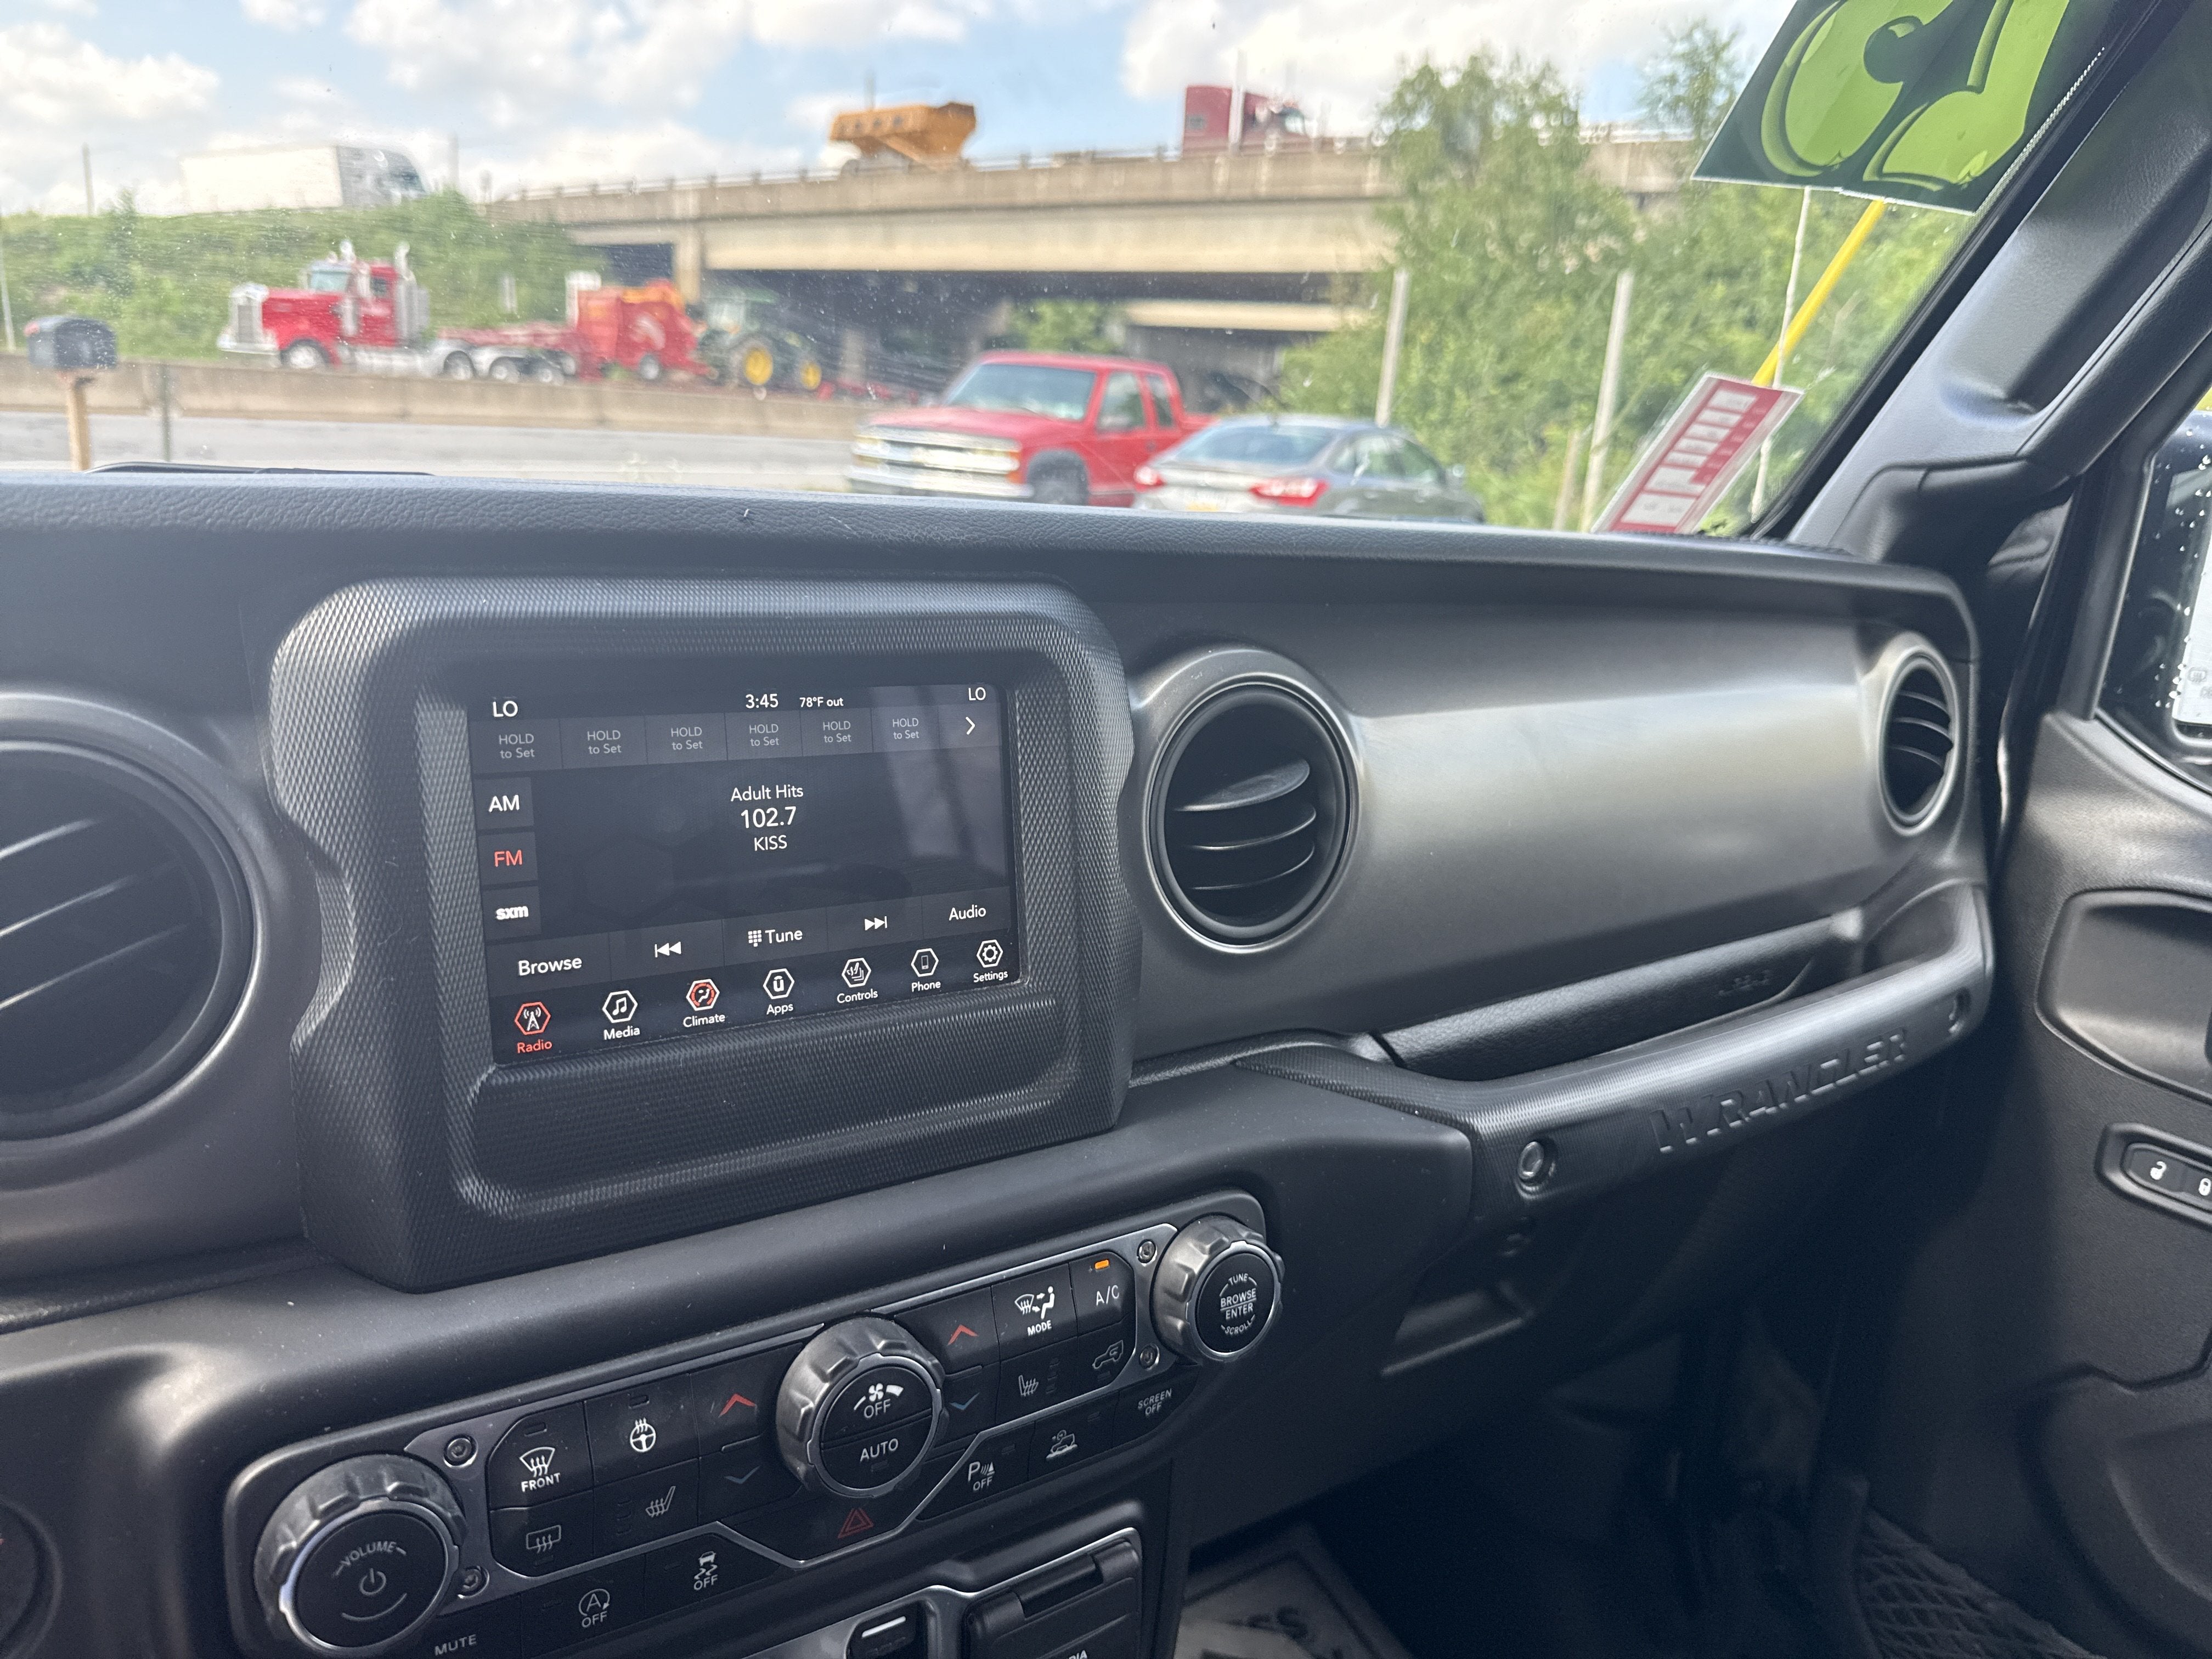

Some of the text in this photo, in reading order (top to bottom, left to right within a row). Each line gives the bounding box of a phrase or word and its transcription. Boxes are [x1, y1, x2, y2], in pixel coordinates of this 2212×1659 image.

[746, 693, 778, 709] 3:45
[968, 687, 986, 701] LO
[492, 700, 518, 717] LO
[826, 697, 844, 707] out
[749, 724, 779, 734] HOLD
[822, 720, 851, 731] HOLD
[892, 718, 919, 727] HOLD
[499, 733, 534, 745] HOLD
[587, 730, 621, 741] HOLD
[670, 726, 702, 737] HOLD
[823, 733, 851, 743] to Set
[893, 730, 919, 740] to Set
[588, 743, 622, 754] to Set
[672, 740, 703, 751] to Set
[750, 736, 779, 747] to Set
[500, 747, 535, 759] to Set
[730, 784, 804, 802] Adult Hits
[488, 794, 520, 812] AM
[741, 806, 797, 828] 102.7
[754, 834, 787, 851] KISS
[494, 850, 522, 867] FM
[495, 906, 529, 920] sxm
[949, 904, 986, 921] Audio
[765, 929, 803, 944] Tune
[518, 957, 582, 976] Browse
[973, 971, 1008, 983] Settings
[911, 981, 941, 992] Phone
[837, 988, 878, 1003] Controls
[766, 1003, 794, 1016] Apps
[682, 1014, 726, 1028] Climate
[603, 1025, 640, 1040] Media
[517, 1039, 552, 1053] Radio
[1229, 1273, 1248, 1285] TUNE
[1096, 1284, 1120, 1306] A/C
[1221, 1287, 1257, 1307] BROWSE
[1225, 1302, 1255, 1321] ENTER
[1027, 1319, 1052, 1336] MODE
[1224, 1321, 1253, 1335] SCROLL
[1138, 1389, 1172, 1409] SCREEN
[864, 1398, 891, 1419] OFF
[1145, 1401, 1163, 1416] OFF
[860, 1438, 899, 1462] AUTO
[521, 1472, 560, 1492] FRONT
[973, 1476, 992, 1491] OFF
[341, 1541, 397, 1567] VOLUME
[693, 1574, 718, 1591] OFF
[581, 1610, 608, 1628] OFF
[435, 1634, 476, 1656] MUTE
